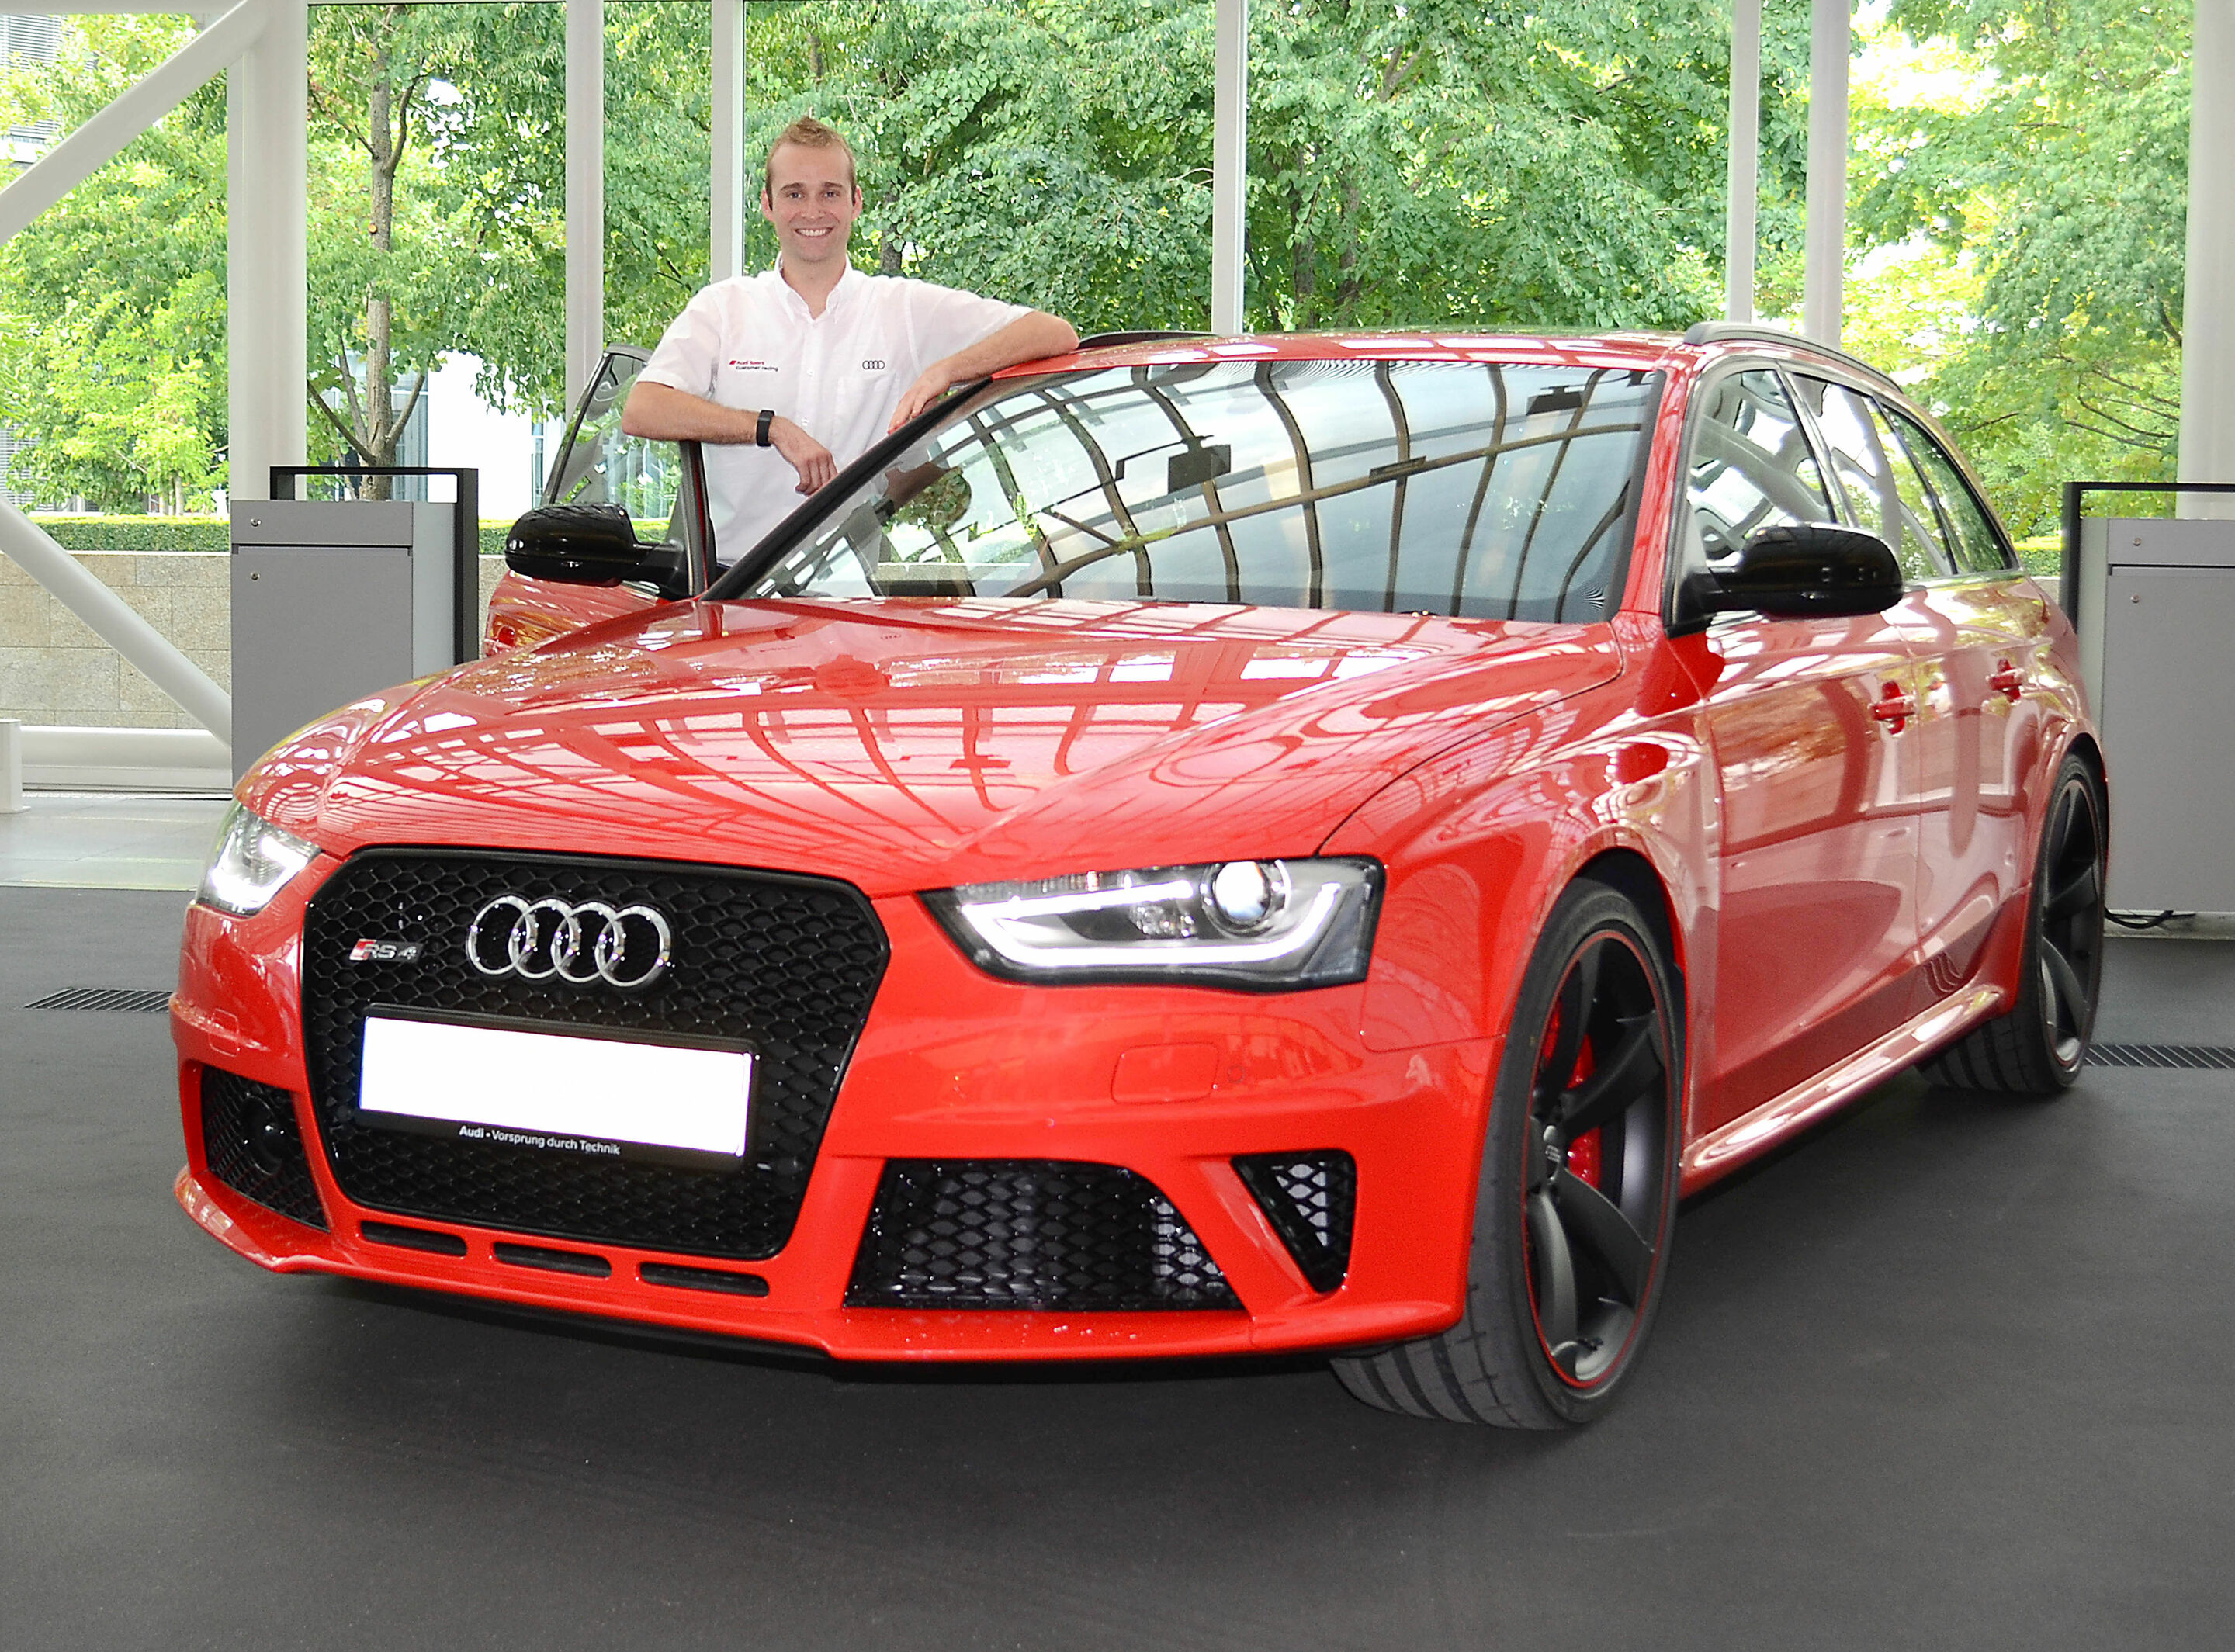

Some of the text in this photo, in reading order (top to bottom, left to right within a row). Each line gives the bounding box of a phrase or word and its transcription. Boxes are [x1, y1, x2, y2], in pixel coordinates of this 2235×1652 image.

[459, 1126, 621, 1155] Audi Vorsprung durch Technik
